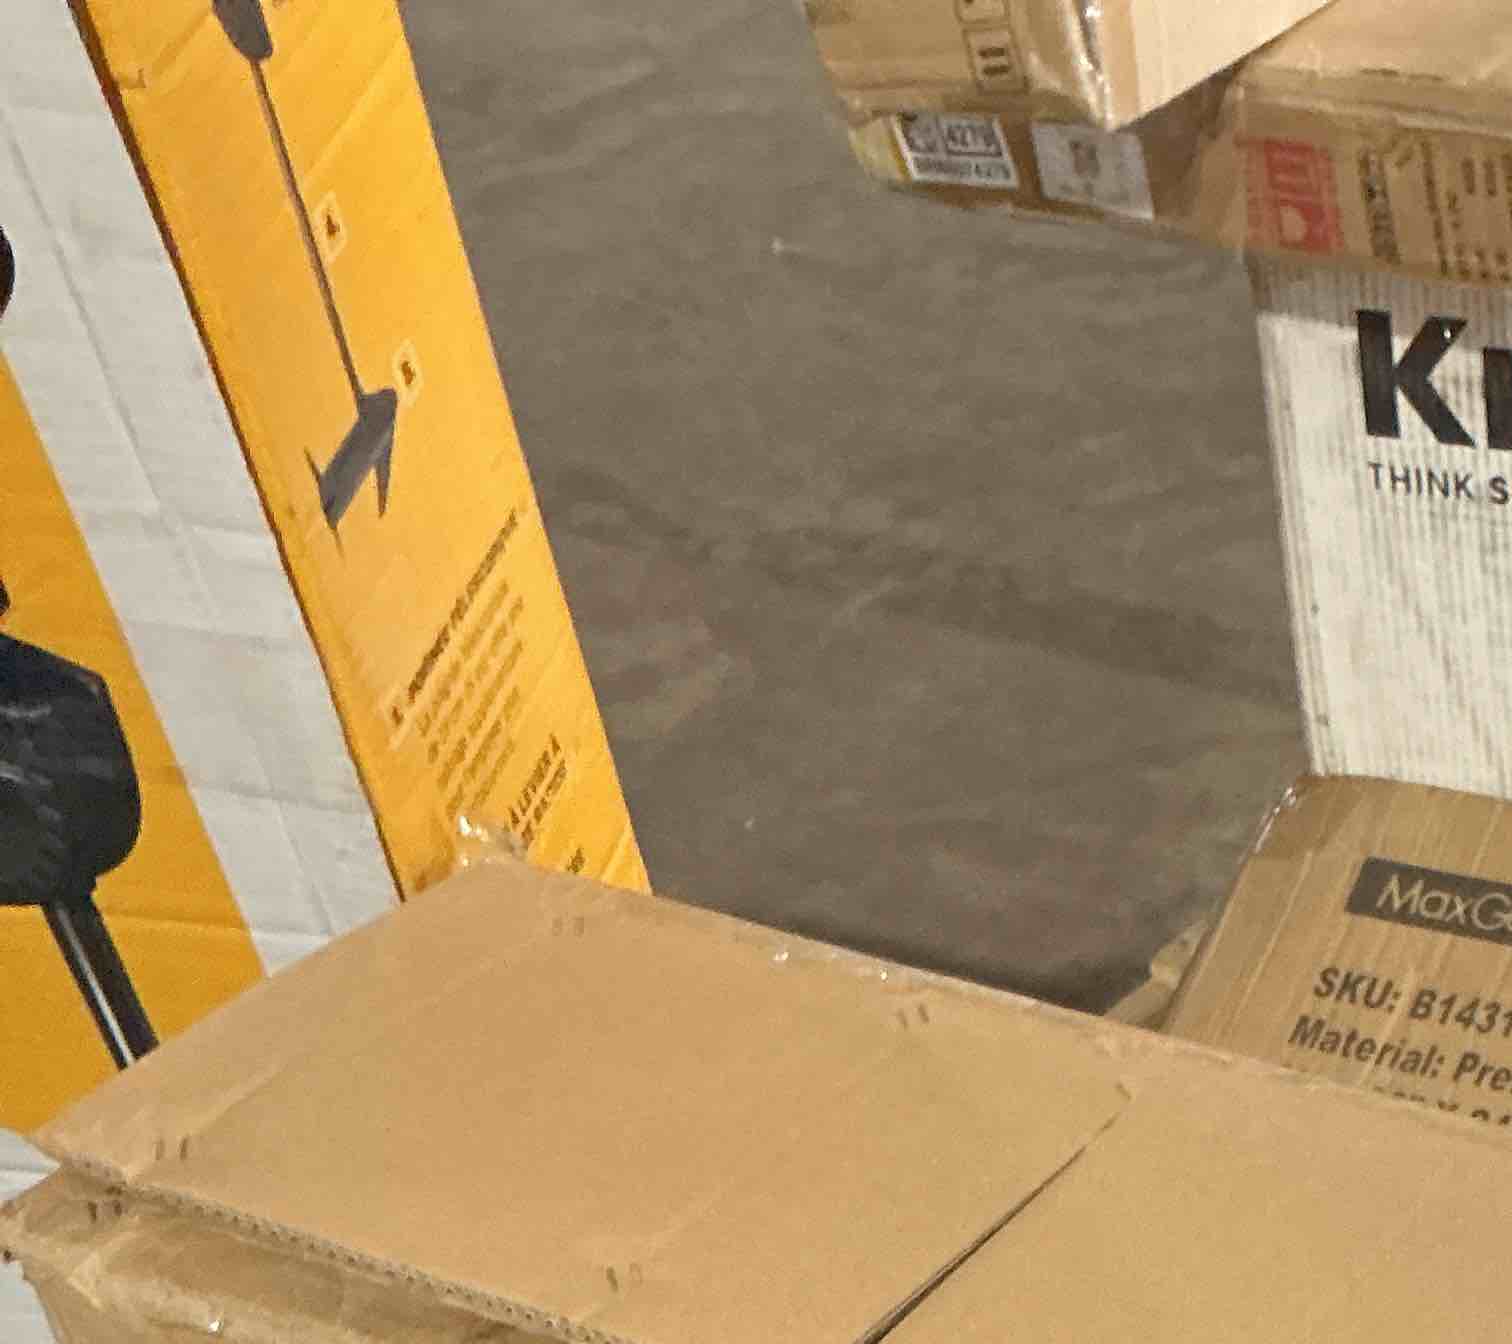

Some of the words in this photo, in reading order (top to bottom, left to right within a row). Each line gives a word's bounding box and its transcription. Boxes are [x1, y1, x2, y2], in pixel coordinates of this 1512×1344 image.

[1368, 461, 1474, 499] THINK
[1312, 967, 1401, 1013] SKU:
[1287, 1014, 1447, 1080] Material:
